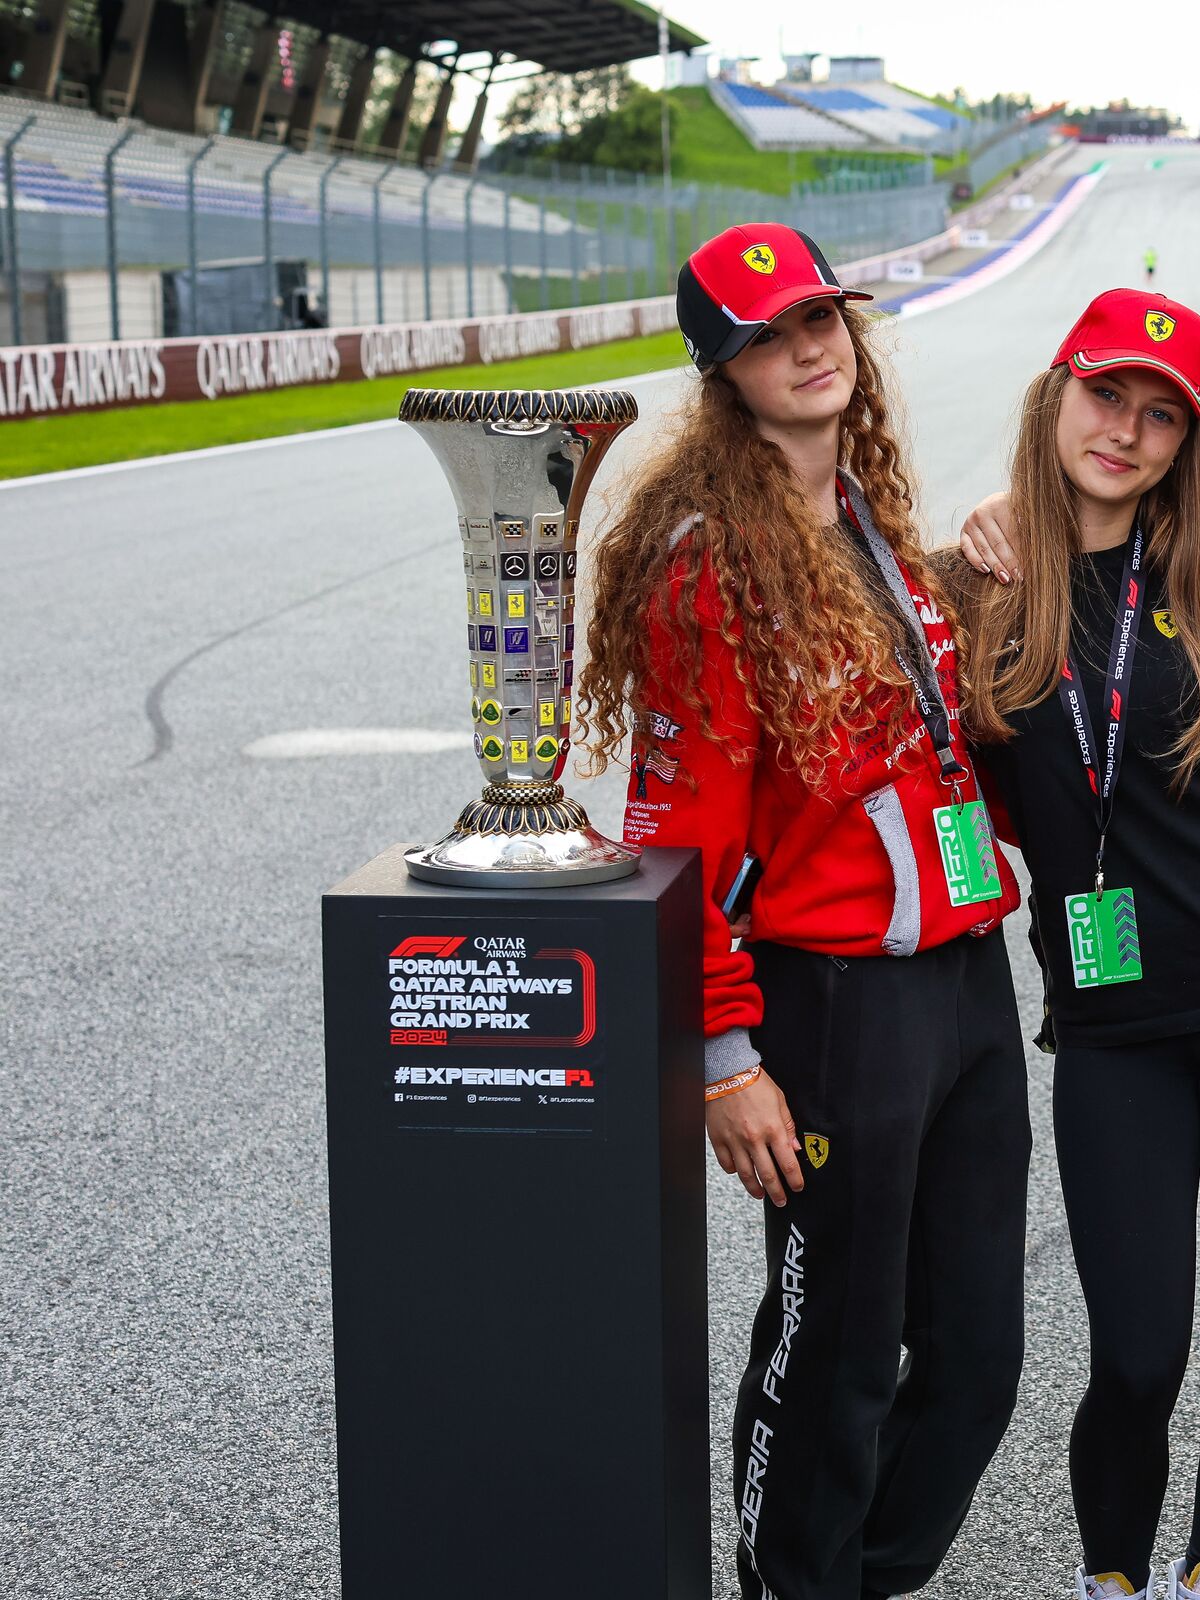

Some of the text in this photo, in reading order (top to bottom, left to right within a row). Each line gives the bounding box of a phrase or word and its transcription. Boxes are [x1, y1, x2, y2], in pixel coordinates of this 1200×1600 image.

[62, 343, 166, 408] AIRWAYS
[197, 335, 340, 400] QATAR AIRWAYS
[1114, 610, 1135, 680] Experiences
[1067, 689, 1092, 765] Experiences
[1103, 722, 1119, 798] Experiences
[937, 808, 969, 905] HERO
[474, 936, 525, 950] QATAR
[486, 950, 527, 958] AIRWAYS
[1069, 896, 1099, 986] HERO
[388, 959, 520, 976] FORMULA 1
[389, 977, 573, 994] QATAR AIRWAYS
[389, 995, 507, 1011] AUSTRIAN
[390, 1012, 530, 1029] GRAND PRIX
[390, 1030, 448, 1045] 2024
[394, 1066, 594, 1087] #EXPERIENCEF1
[762, 1222, 804, 1405] FERRARI
